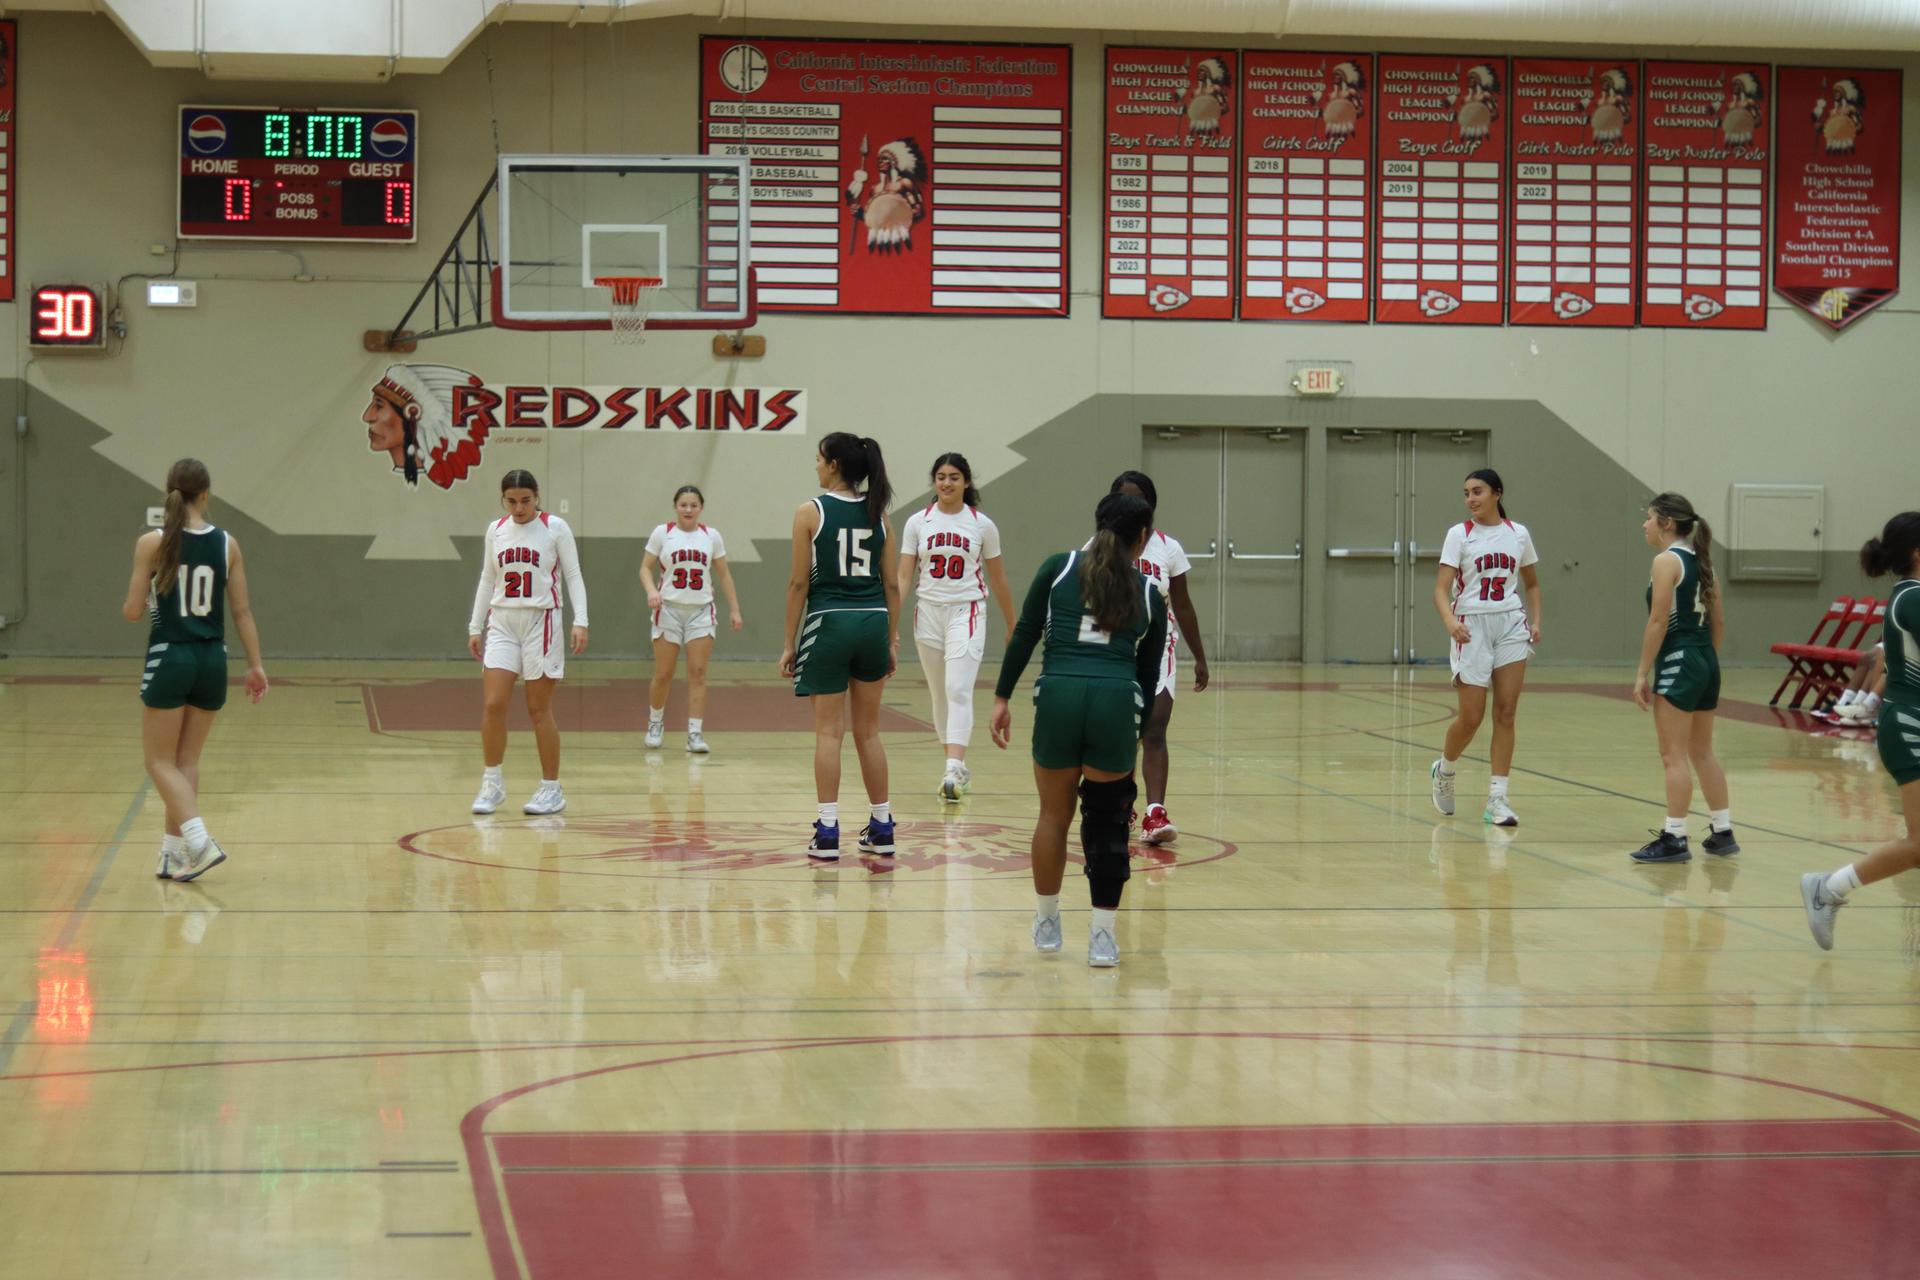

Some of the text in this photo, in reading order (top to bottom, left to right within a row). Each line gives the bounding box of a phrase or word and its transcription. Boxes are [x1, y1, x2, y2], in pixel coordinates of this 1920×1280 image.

[776, 51, 1057, 75] California Interscholastic Federation
[1113, 63, 1189, 74] CHOWCHILLA
[1250, 66, 1324, 77] CHOWCHILLA
[1385, 70, 1459, 81] CHOWCHILLA
[1111, 77, 1191, 88] HIGH SCHOOL
[1519, 73, 1592, 84] CHOWCHILLA
[1651, 76, 1724, 87] CHOWCHILLA
[800, 74, 1033, 99] Central Section Champions
[1248, 81, 1327, 92] HIGH SCHOOL
[1383, 84, 1460, 95] HIGH SCHOOL
[1128, 91, 1172, 101] LEAGUE
[1517, 88, 1594, 99] HIGH SCHOOL
[1650, 90, 1725, 101] HIGH SCHOOL
[1264, 95, 1308, 104] LEAGUE
[1400, 98, 1442, 108] LEAGUE
[714, 105, 833, 116] 2018 GIRLS BASKETBALL
[1116, 104, 1184, 115] CHAMPIONS
[1533, 101, 1577, 111] LEAGUE
[1665, 104, 1706, 114] LEAGUE
[1252, 108, 1319, 118] CHAMPIONS
[1387, 111, 1454, 122] CHAMPIONS
[1522, 114, 1588, 125] CHAMPIONS
[1653, 117, 1718, 128] CHAMPIONS
[711, 125, 836, 136] 2018 BOYS CROSS COUNTRY
[264, 115, 362, 158] 8:00
[1109, 133, 1232, 148] Boys Track & Field
[1263, 136, 1345, 153] Girls Golf
[1398, 139, 1481, 156] Boys Golf
[1517, 141, 1633, 156] Girls Water Polo
[752, 147, 823, 157] VOLLEYBALL
[1647, 143, 1765, 160] Boys Water Polo
[191, 160, 239, 174] HOME
[1117, 157, 1141, 167] 1978
[1254, 160, 1279, 170] 2018
[274, 164, 319, 176] PERIOD
[349, 163, 404, 178] GUEST
[757, 168, 819, 178] BASEBALL
[1388, 163, 1413, 173] 2004
[1522, 166, 1547, 175] 2019
[1804, 163, 1872, 175] Chowchilla
[1117, 178, 1141, 187] 1982
[1802, 176, 1874, 188] High School
[754, 188, 780, 197] BOYS
[781, 189, 813, 197] TENNIS
[1388, 184, 1413, 193] 2019
[1522, 187, 1547, 196] 2022
[225, 178, 251, 220] 0
[280, 193, 315, 204] POSS
[1808, 190, 1868, 200] California
[386, 182, 411, 224] 0
[1117, 199, 1141, 208] 1986
[1794, 202, 1881, 214] Interscholastic
[276, 208, 318, 219] BONUS
[1117, 219, 1140, 229] 1987
[1807, 215, 1868, 227] Federation
[1801, 228, 1874, 240] Division 4-A
[1117, 241, 1139, 250] 2022
[1785, 241, 1839, 252] Southern
[1116, 261, 1139, 271] 2023
[1781, 254, 1893, 268] Football Champions
[1822, 268, 1851, 278] 2015
[38, 291, 93, 337] 30
[1308, 370, 1332, 389] EXIT
[452, 386, 802, 431] REDSKINS
[927, 531, 970, 553] TRIBE
[497, 547, 540, 568] TRIBE
[671, 549, 708, 566] TRIBE
[836, 527, 874, 577] 15
[929, 554, 965, 580] 30
[1474, 552, 1517, 575] TRIBE
[504, 571, 532, 598] 21
[672, 568, 704, 591] 35
[178, 564, 215, 617] 10
[1479, 576, 1508, 601] 15
